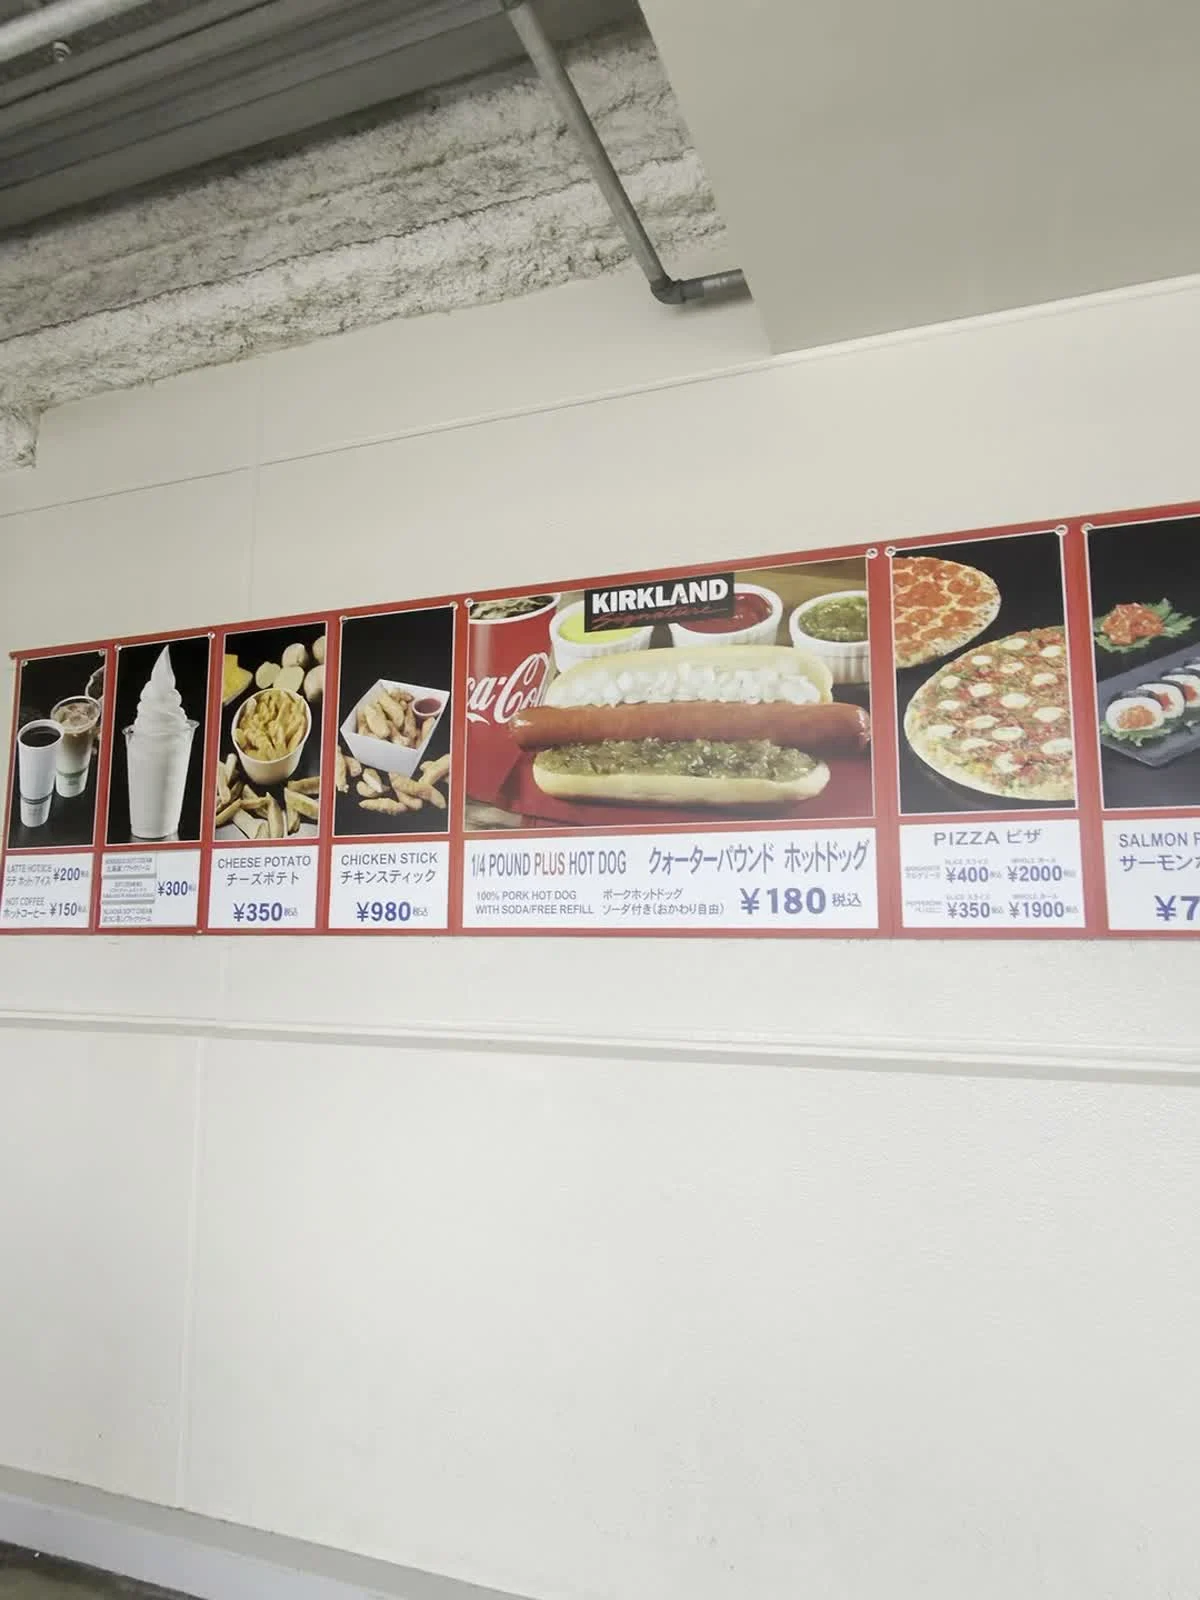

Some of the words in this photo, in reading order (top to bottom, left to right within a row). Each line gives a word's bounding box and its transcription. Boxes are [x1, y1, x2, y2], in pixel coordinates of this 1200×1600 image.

[591, 578, 730, 615] KIRKLAND
[933, 830, 1000, 846] PIZZA
[1118, 831, 1189, 848] SALMON
[217, 856, 262, 869] CHEESE
[264, 855, 312, 868] POTATO
[340, 853, 397, 866] CHICKEN
[399, 851, 439, 864] STICK
[471, 852, 486, 878] 1/4
[488, 852, 532, 877] POUND
[534, 851, 566, 876] PLUS
[568, 850, 595, 876] HOT
[598, 849, 627, 875] DOG
[648, 843, 775, 875] クォーターパウンド
[784, 839, 870, 873] ホットドッグ
[53, 866, 81, 882] ¥200
[225, 870, 300, 887] チーズポテト
[340, 868, 437, 885] チキンスティック
[945, 866, 990, 883] ¥400
[1007, 865, 1063, 882] ¥2000
[157, 880, 188, 897] ¥300
[501, 890, 529, 901] PORK
[531, 890, 552, 901] HOT
[554, 890, 577, 900] DOG
[50, 902, 78, 917] ¥150
[475, 904, 500, 915] WITH
[501, 904, 557, 915] SODA/FREE
[559, 904, 595, 915] REFILL
[739, 887, 827, 915] ¥180
[831, 892, 862, 908] 税込
[232, 902, 283, 922] ¥350
[356, 901, 412, 922] ¥980
[947, 902, 991, 919] ¥350
[1009, 901, 1065, 919] ¥1900
